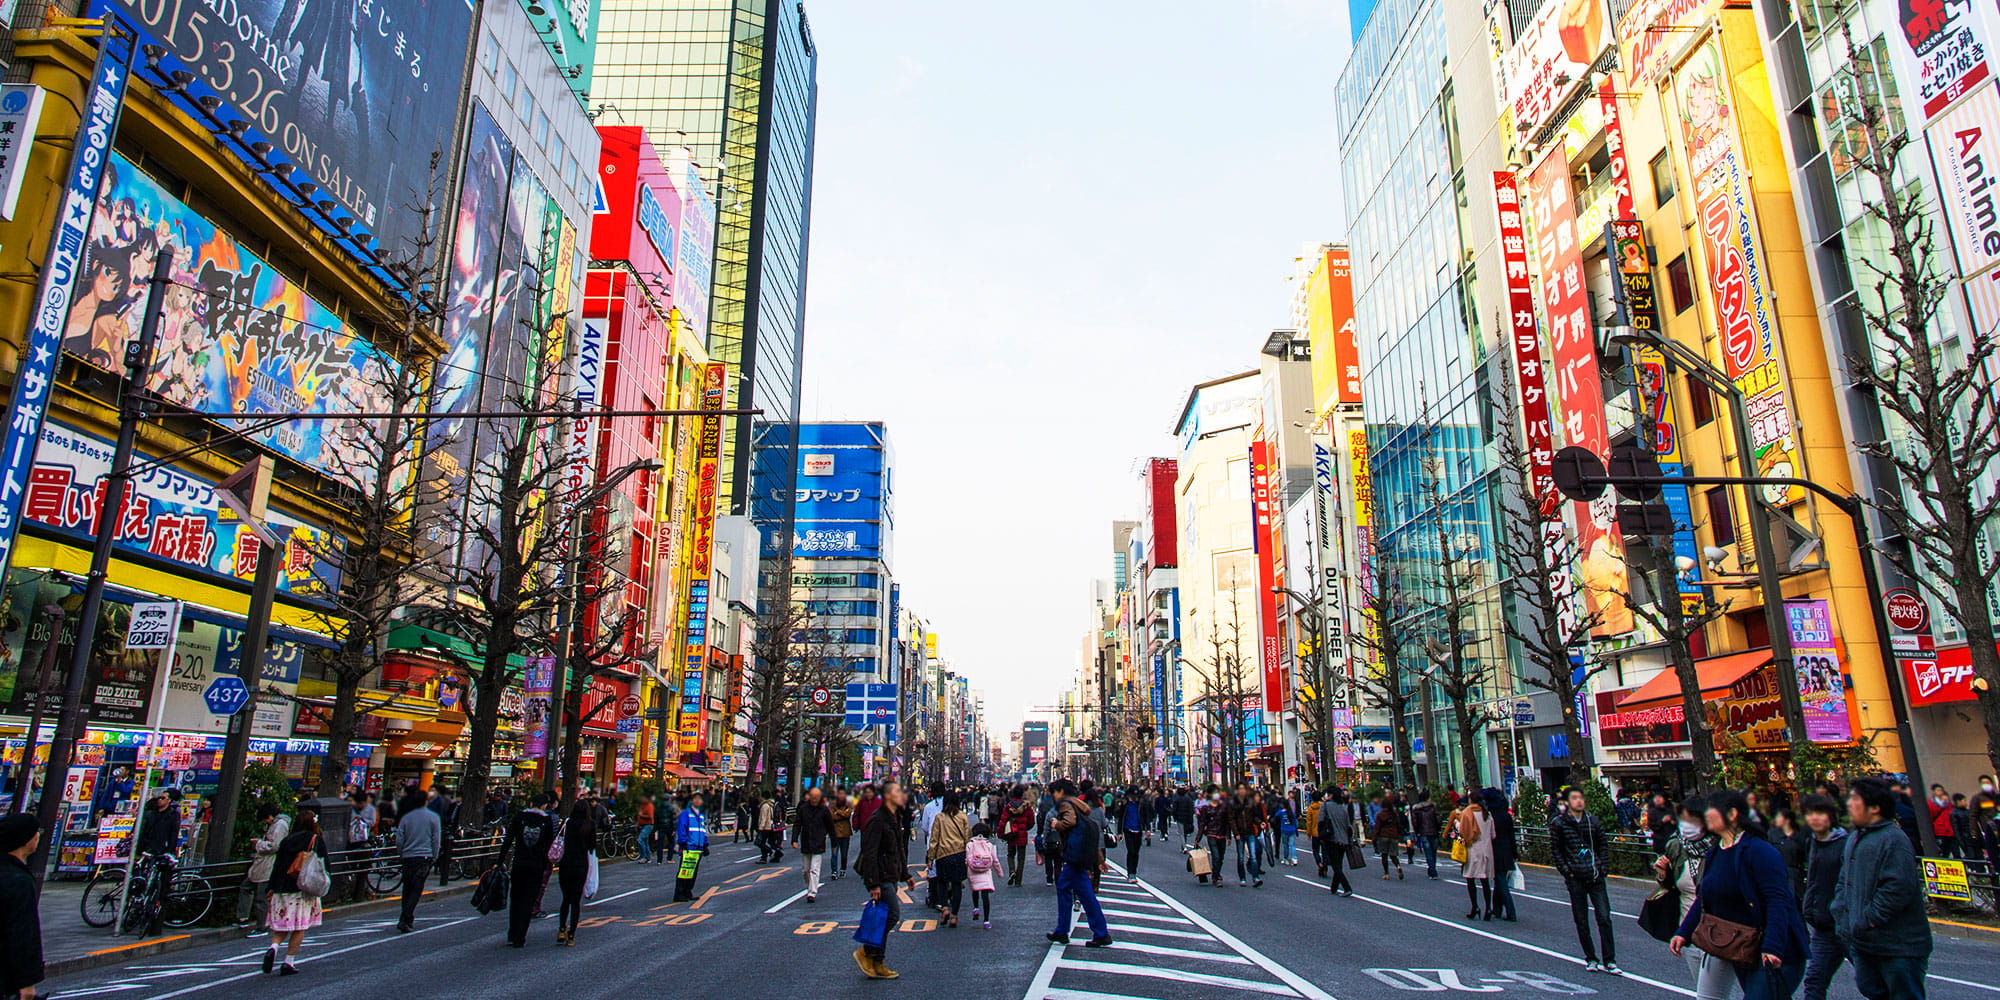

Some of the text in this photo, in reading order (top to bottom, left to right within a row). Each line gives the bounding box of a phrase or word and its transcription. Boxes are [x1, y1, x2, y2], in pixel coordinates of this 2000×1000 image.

[1921, 27, 1974, 80] 赤から鍋
[1920, 42, 1985, 100] セセリ焼き
[1946, 79, 1965, 102] 5F
[125, 0, 367, 218] 015.3.26 ON SALE
[80, 85, 121, 190] 売るのも
[1948, 146, 1967, 194] Produced
[1964, 212, 1981, 254] ADORES
[1955, 126, 2000, 257] Anime
[639, 183, 674, 273] SEGA
[40, 223, 84, 337] 買うのも
[1704, 193, 1758, 371] ラムタラ
[1534, 194, 1586, 442] カラオケパセ
[1634, 315, 1651, 330] CD
[579, 322, 601, 388] AKKY
[1314, 443, 1333, 550] AKKY INTERNATIONAL
[657, 527, 670, 560] GAME
[1325, 567, 1340, 610] DUTY
[133, 620, 168, 631] タクシー
[1890, 604, 1920, 619] 消火栓
[130, 632, 168, 645] のりば
[226, 628, 298, 662] ソップ
[1328, 617, 1343, 659] FREE
[1794, 631, 1829, 642] まつり
[182, 654, 204, 681] 20
[1941, 664, 1975, 684] アド
[160, 677, 205, 695] nniversary
[208, 688, 243, 703] 437
[815, 691, 827, 702] 50
[1753, 728, 1783, 744] ラムタラ
[577, 913, 714, 929] 8-20
[793, 919, 938, 935] 8-0
